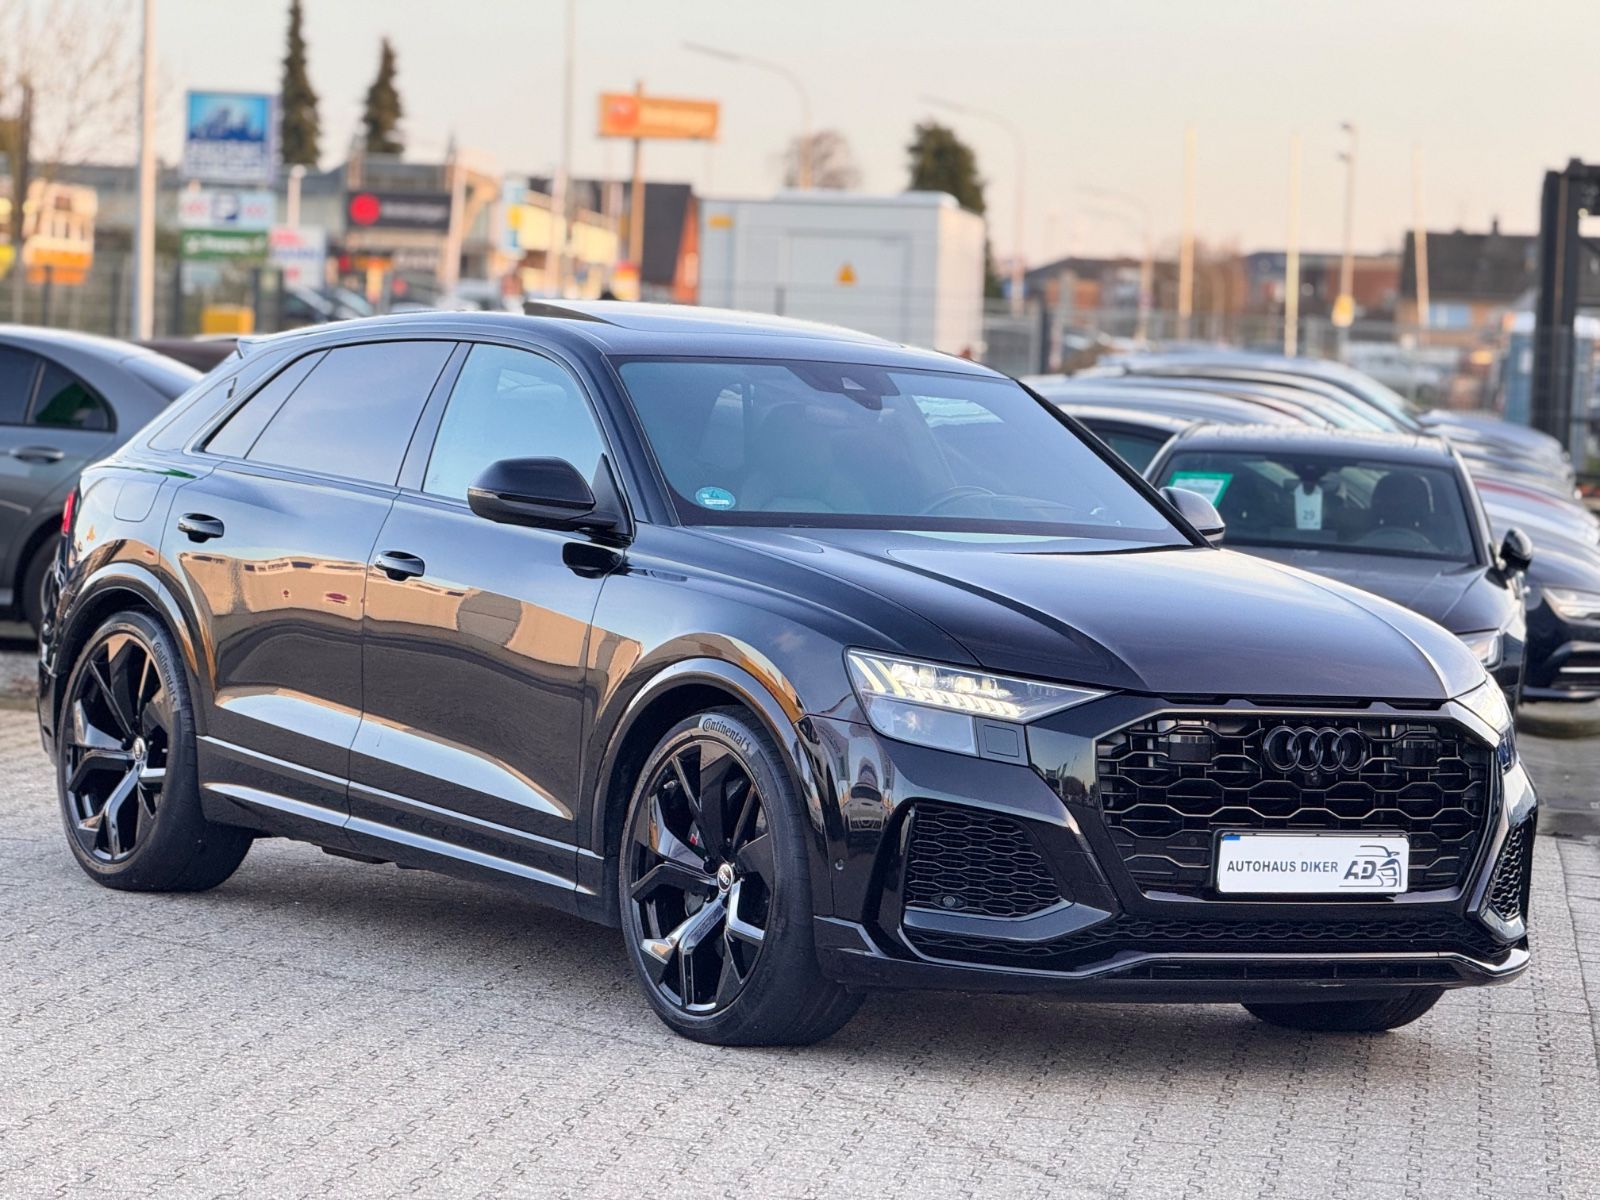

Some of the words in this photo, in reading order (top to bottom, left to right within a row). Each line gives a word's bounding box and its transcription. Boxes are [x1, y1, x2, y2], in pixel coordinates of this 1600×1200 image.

[703, 718, 747, 748] Continental
[1227, 860, 1296, 873] AUTOHAUS
[1300, 861, 1339, 873] DIKER
[1343, 860, 1377, 880] AD
